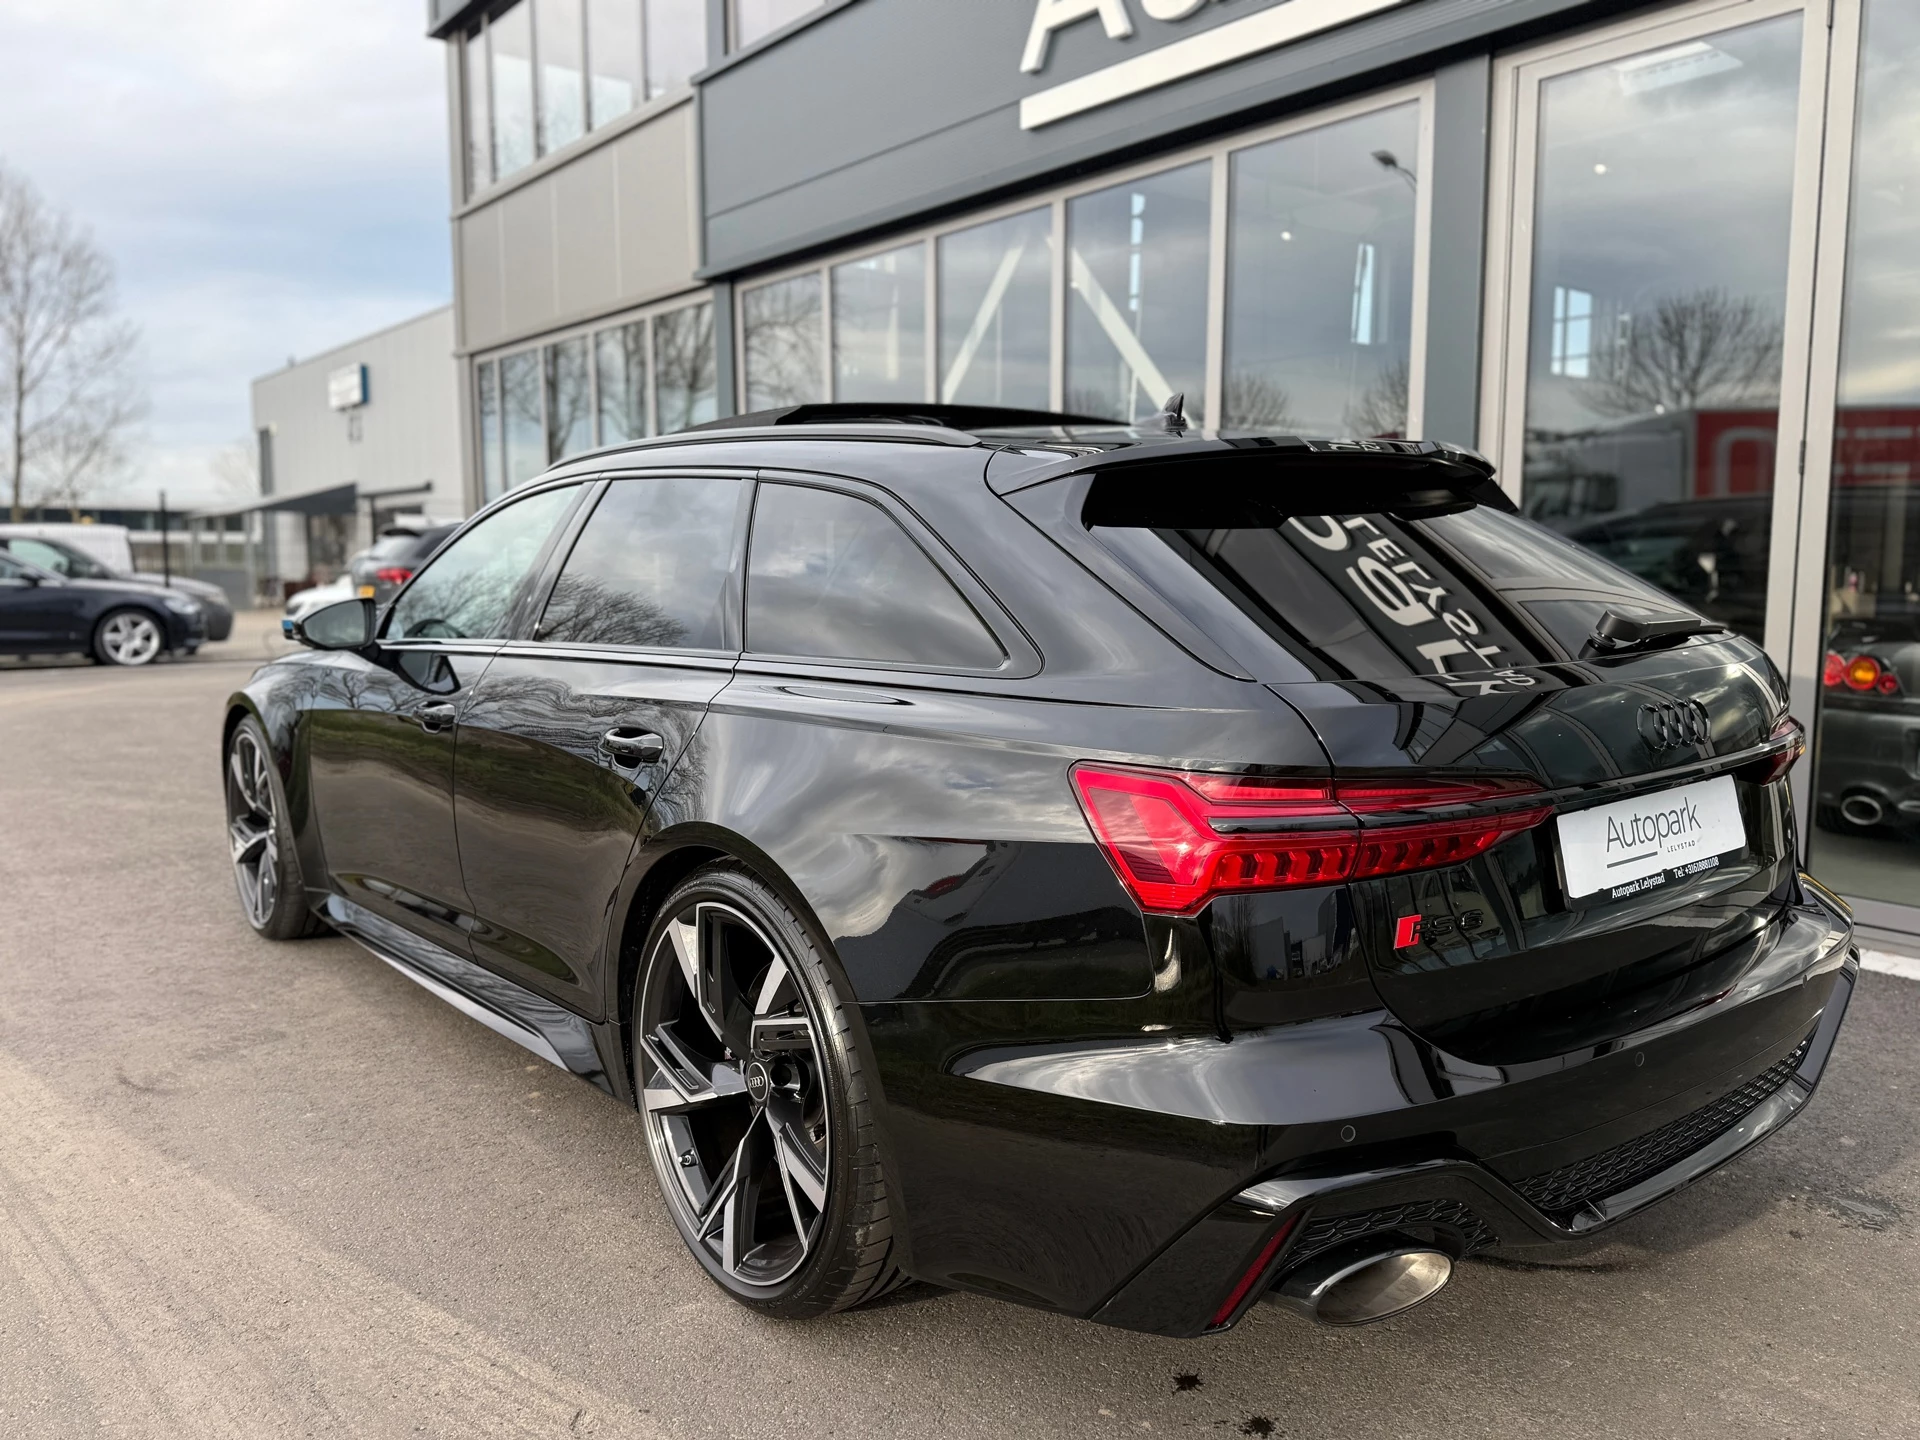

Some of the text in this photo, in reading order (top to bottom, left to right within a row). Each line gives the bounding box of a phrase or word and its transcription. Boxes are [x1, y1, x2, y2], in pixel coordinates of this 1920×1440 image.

[1606, 797, 1702, 853] Autopark
[1667, 839, 1696, 853] LELYSTAD
[1612, 882, 1641, 899] Autopark
[1640, 873, 1666, 889] Lelystad
